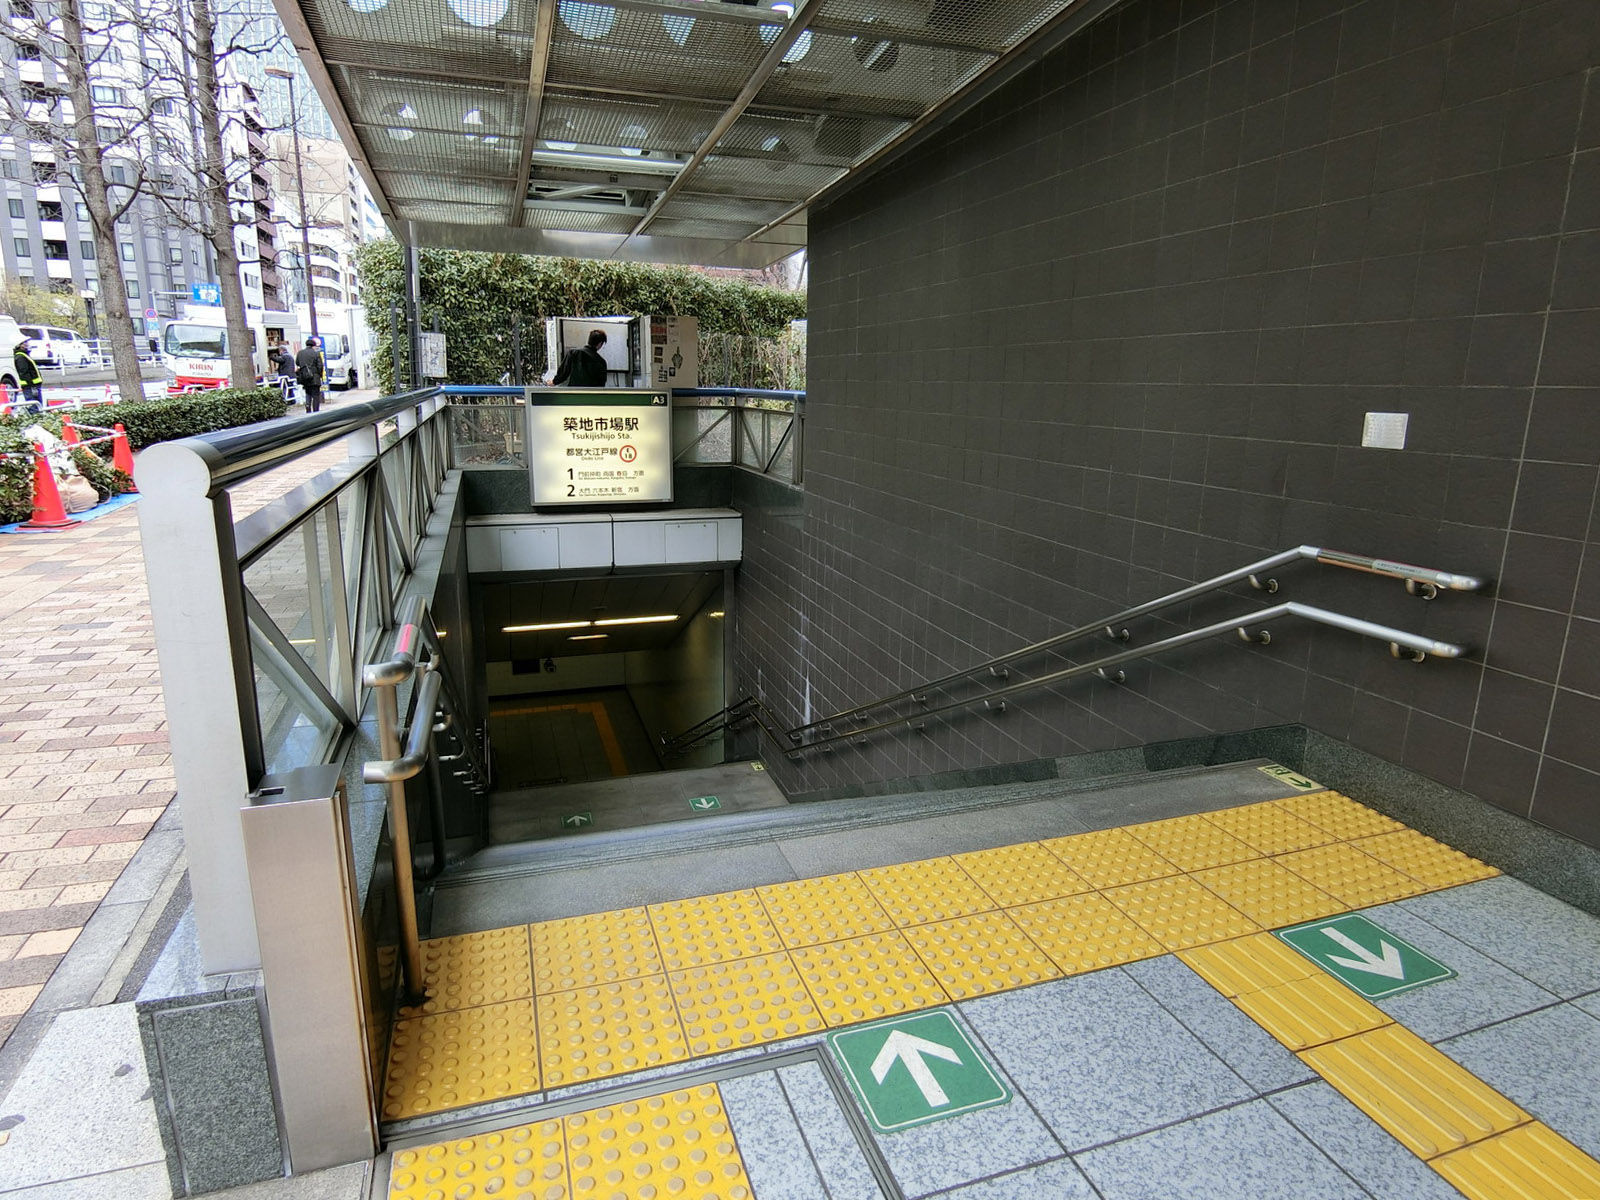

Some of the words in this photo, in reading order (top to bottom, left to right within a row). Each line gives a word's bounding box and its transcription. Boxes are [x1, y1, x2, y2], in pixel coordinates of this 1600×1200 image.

[189, 363, 214, 371] KIRIN
[652, 395, 665, 405] A3
[563, 417, 639, 431] 築地市場駅
[572, 433, 616, 441] Tsukijishijo
[617, 432, 632, 440] Sta.
[566, 447, 618, 456] 都営大江戸線
[567, 467, 574, 480] 1
[567, 484, 575, 497] 2
